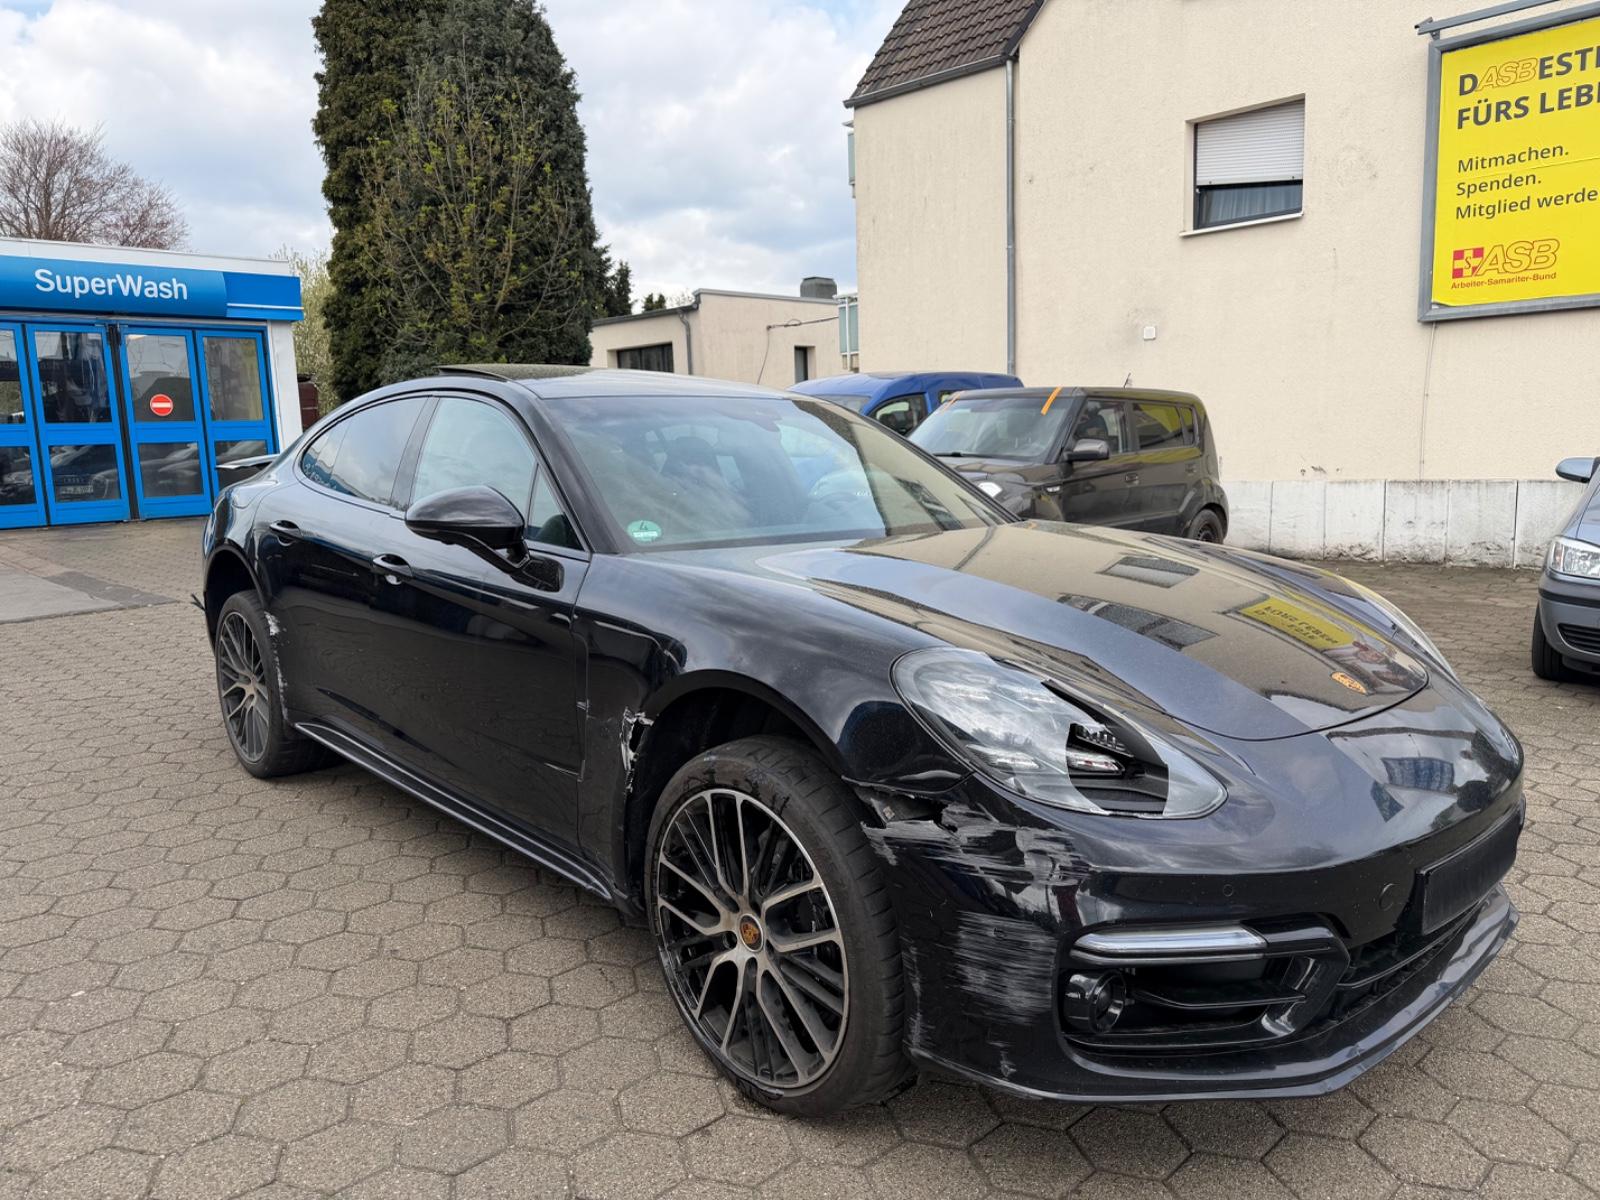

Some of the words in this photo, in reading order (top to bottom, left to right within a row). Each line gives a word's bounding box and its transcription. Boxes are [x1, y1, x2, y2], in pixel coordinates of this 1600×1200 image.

[1459, 46, 1600, 96] DASBEST
[1457, 96, 1530, 130] FÜRS
[1539, 81, 1600, 114] LEB
[1458, 144, 1569, 174] Mitmachen.
[1456, 174, 1542, 199] Spenden.
[1456, 196, 1531, 220] Mitglied
[1473, 238, 1560, 277] ASB
[34, 268, 188, 300] SuperWash
[1451, 272, 1557, 290] Arbeiter-Samariter-Bund
